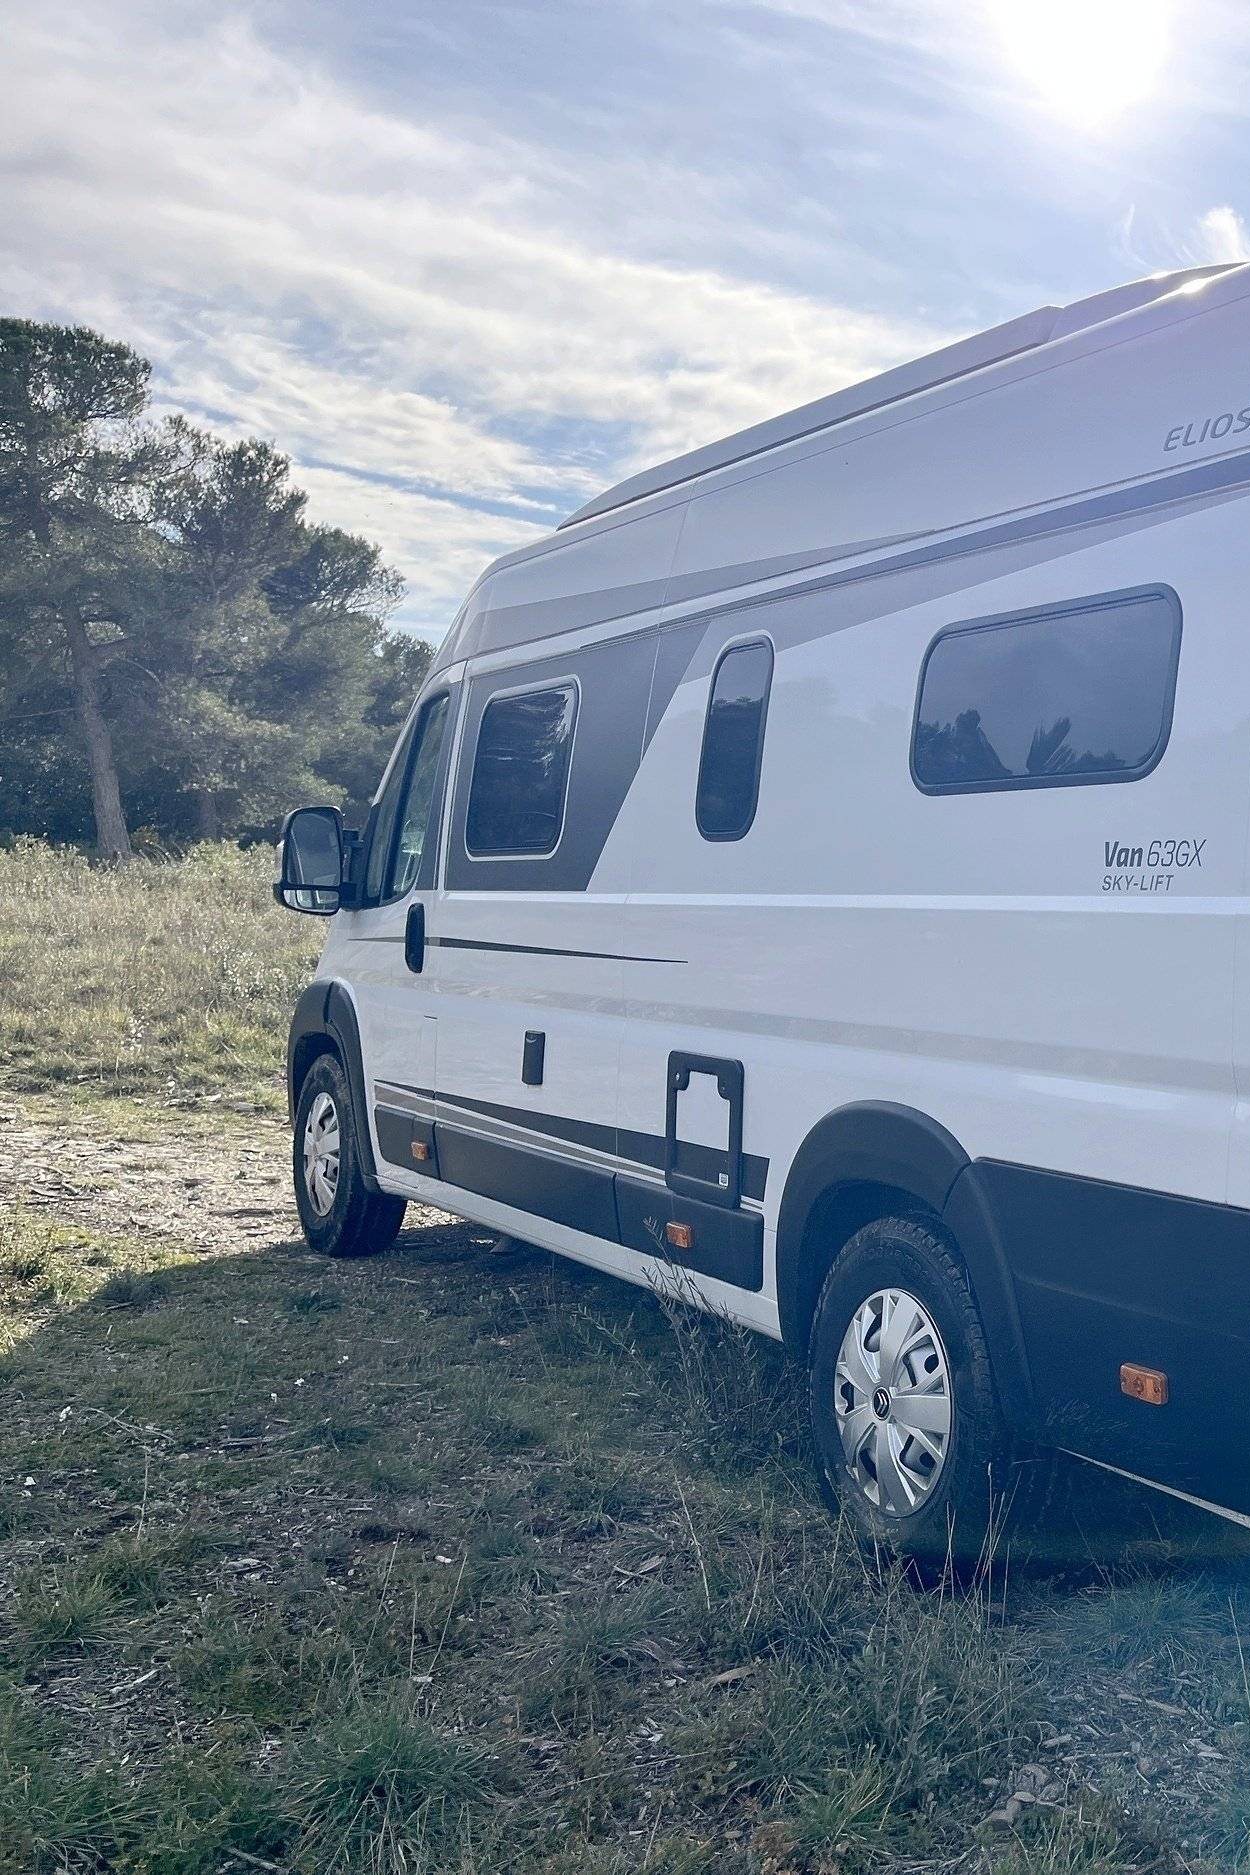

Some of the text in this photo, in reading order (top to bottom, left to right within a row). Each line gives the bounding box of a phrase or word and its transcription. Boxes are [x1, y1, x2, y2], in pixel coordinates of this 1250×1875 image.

[1104, 839, 1207, 868] Van 63GX
[1102, 875, 1174, 891] SKY-LIFT
